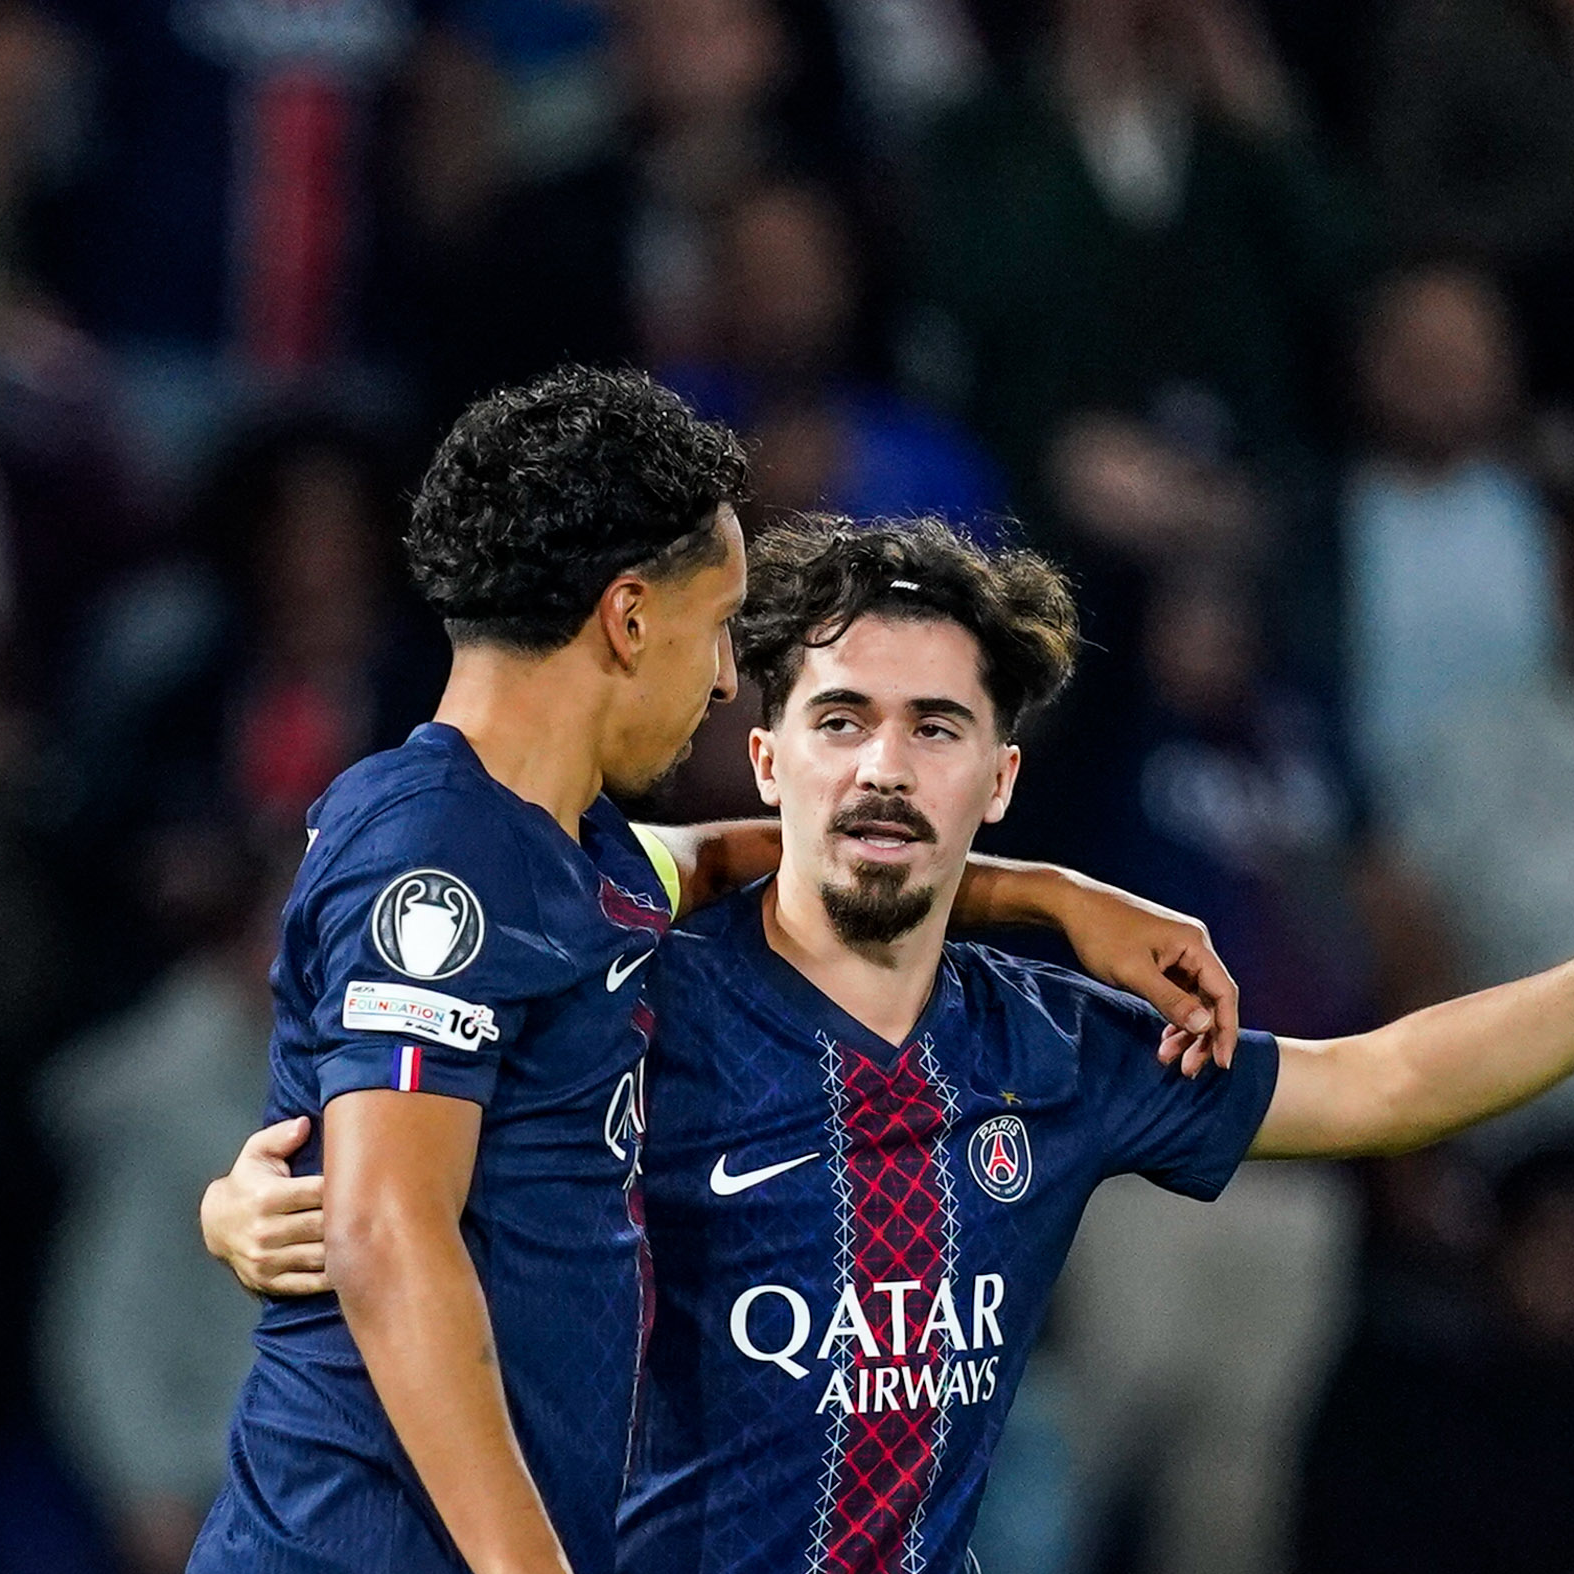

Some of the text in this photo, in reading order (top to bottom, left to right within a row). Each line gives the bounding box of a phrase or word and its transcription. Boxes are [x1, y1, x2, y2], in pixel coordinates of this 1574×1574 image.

[348, 998, 445, 1023] FOUNDATION
[449, 1009, 480, 1040] 10
[978, 1119, 1021, 1140] PARIS
[728, 1272, 1005, 1380] QATAR
[815, 1355, 1000, 1415] AIRWAYS
